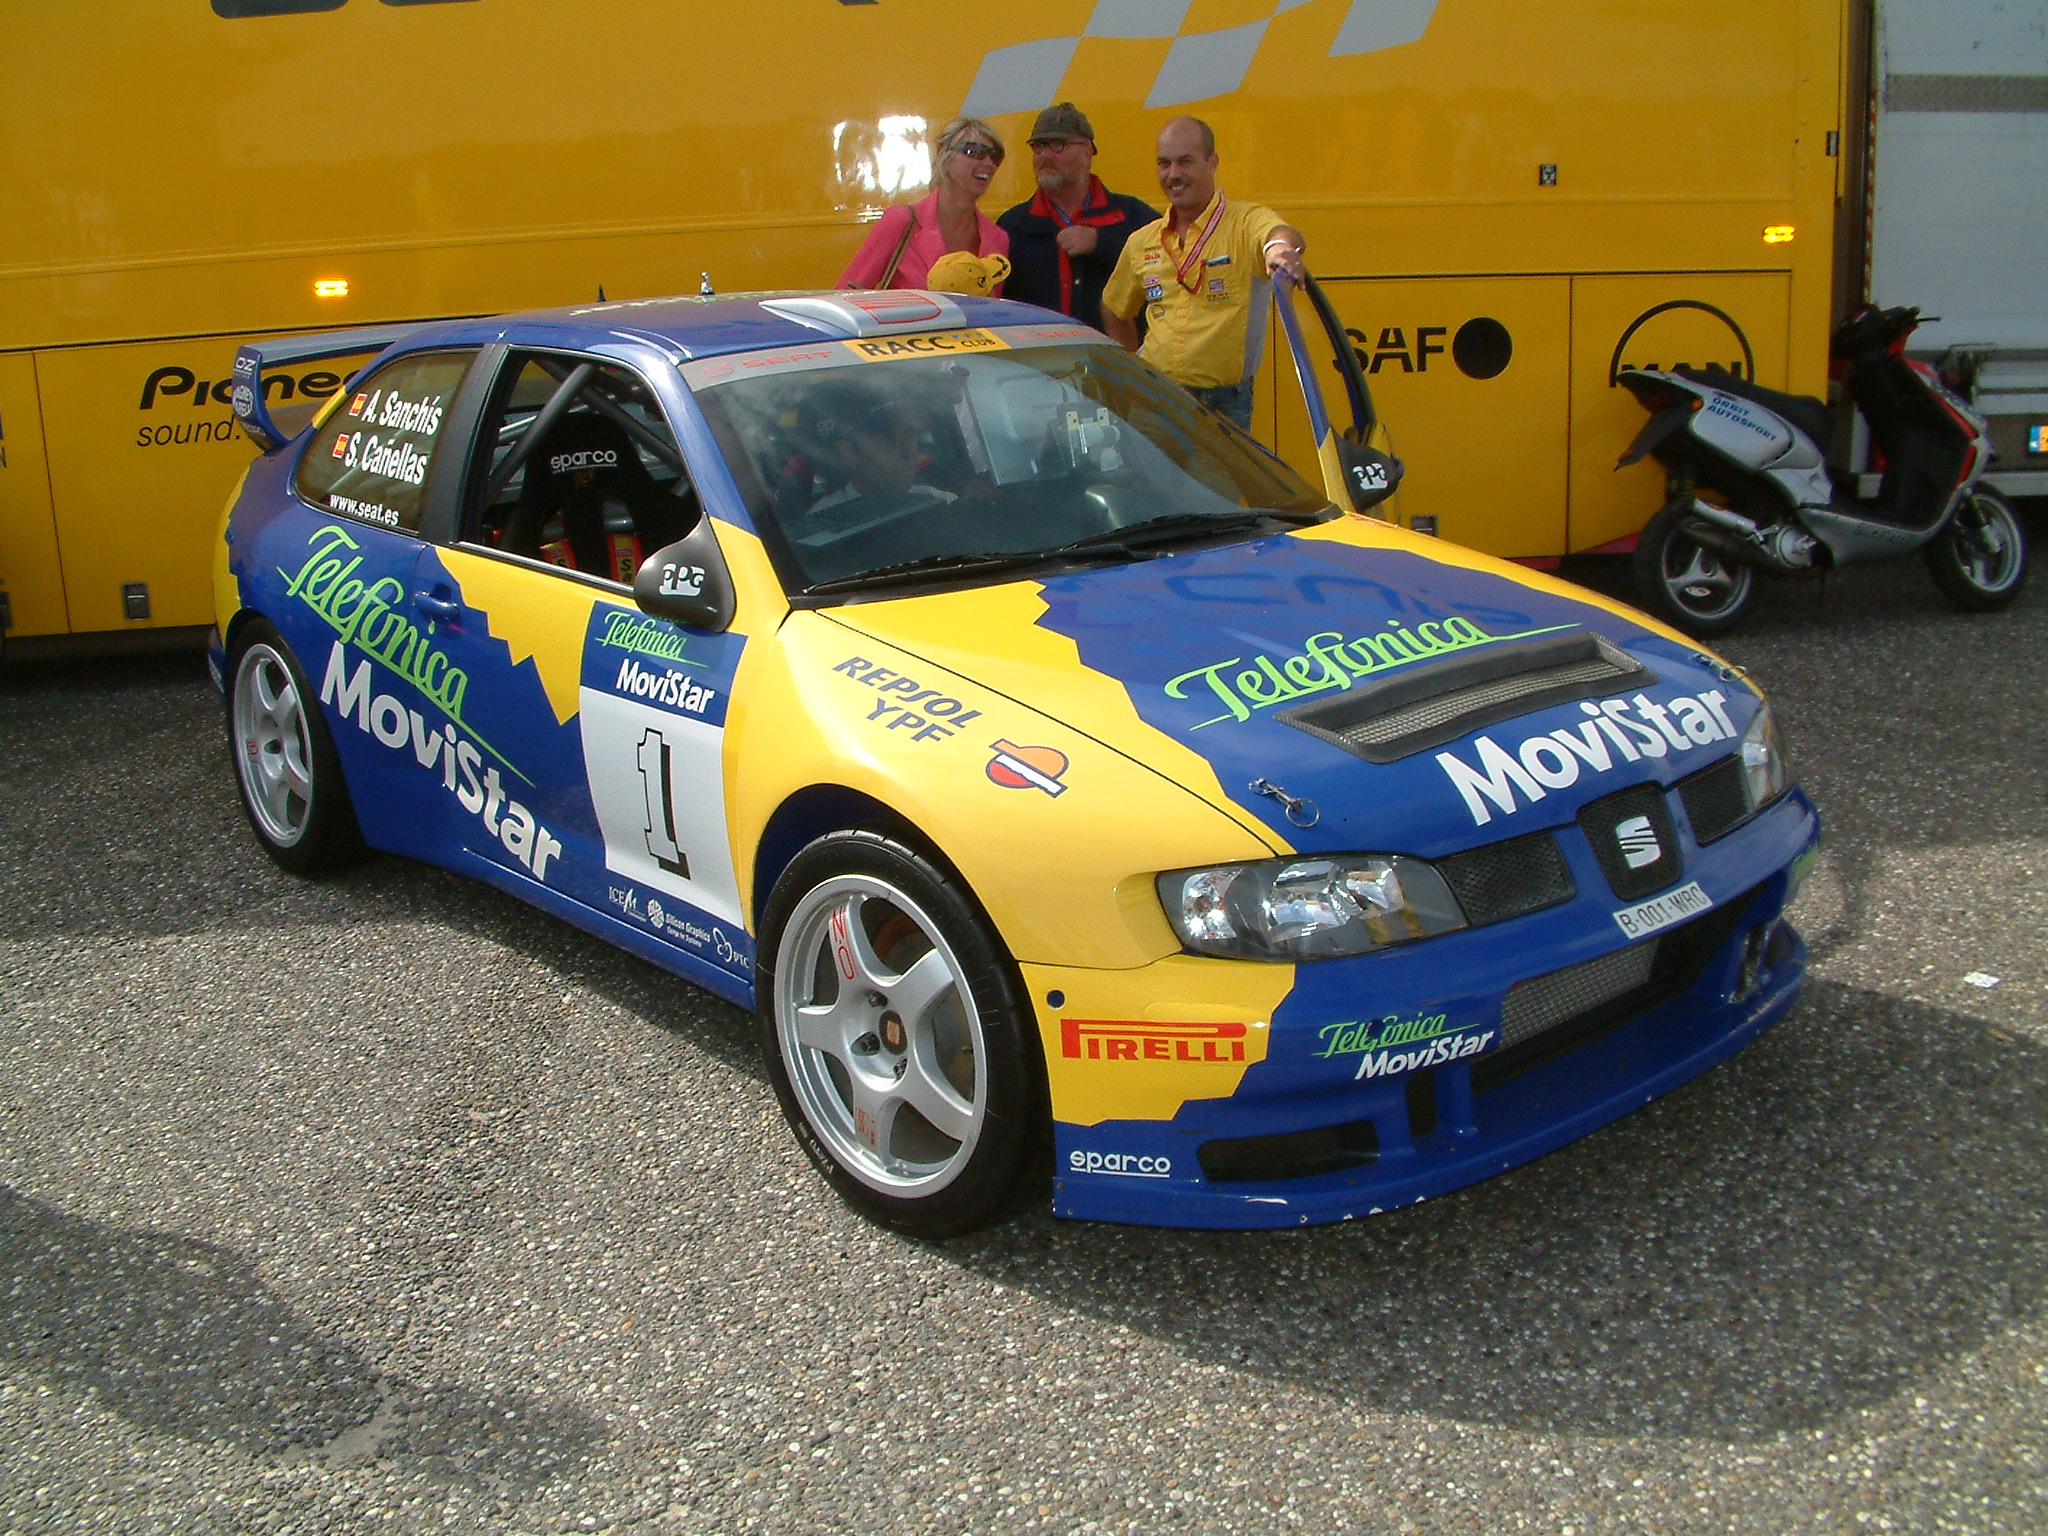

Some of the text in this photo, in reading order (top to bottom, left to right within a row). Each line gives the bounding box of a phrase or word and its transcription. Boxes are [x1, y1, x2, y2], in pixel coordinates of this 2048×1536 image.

[742, 350, 832, 368] SEAT
[859, 336, 954, 356] RACC
[960, 338, 996, 349] CLUB
[361, 389, 443, 436] A. Sanchís
[1706, 404, 1777, 441] AUTOSPORT
[1713, 397, 1750, 415] ORBIT
[344, 431, 427, 485] S. Cañellas
[550, 450, 617, 471] sparco
[329, 494, 399, 526] www.seat.es
[659, 563, 705, 597] PPG
[616, 658, 716, 714] MoviStar
[831, 656, 983, 729] REPSOL
[866, 697, 955, 742] YPF
[320, 640, 562, 881] MoviStar
[1435, 688, 1739, 827] MoviStar
[635, 726, 692, 881] 1
[1060, 1018, 1247, 1062] PIRELLI
[1354, 1031, 1494, 1080] MoviStar
[1070, 1149, 1171, 1175] sparco
